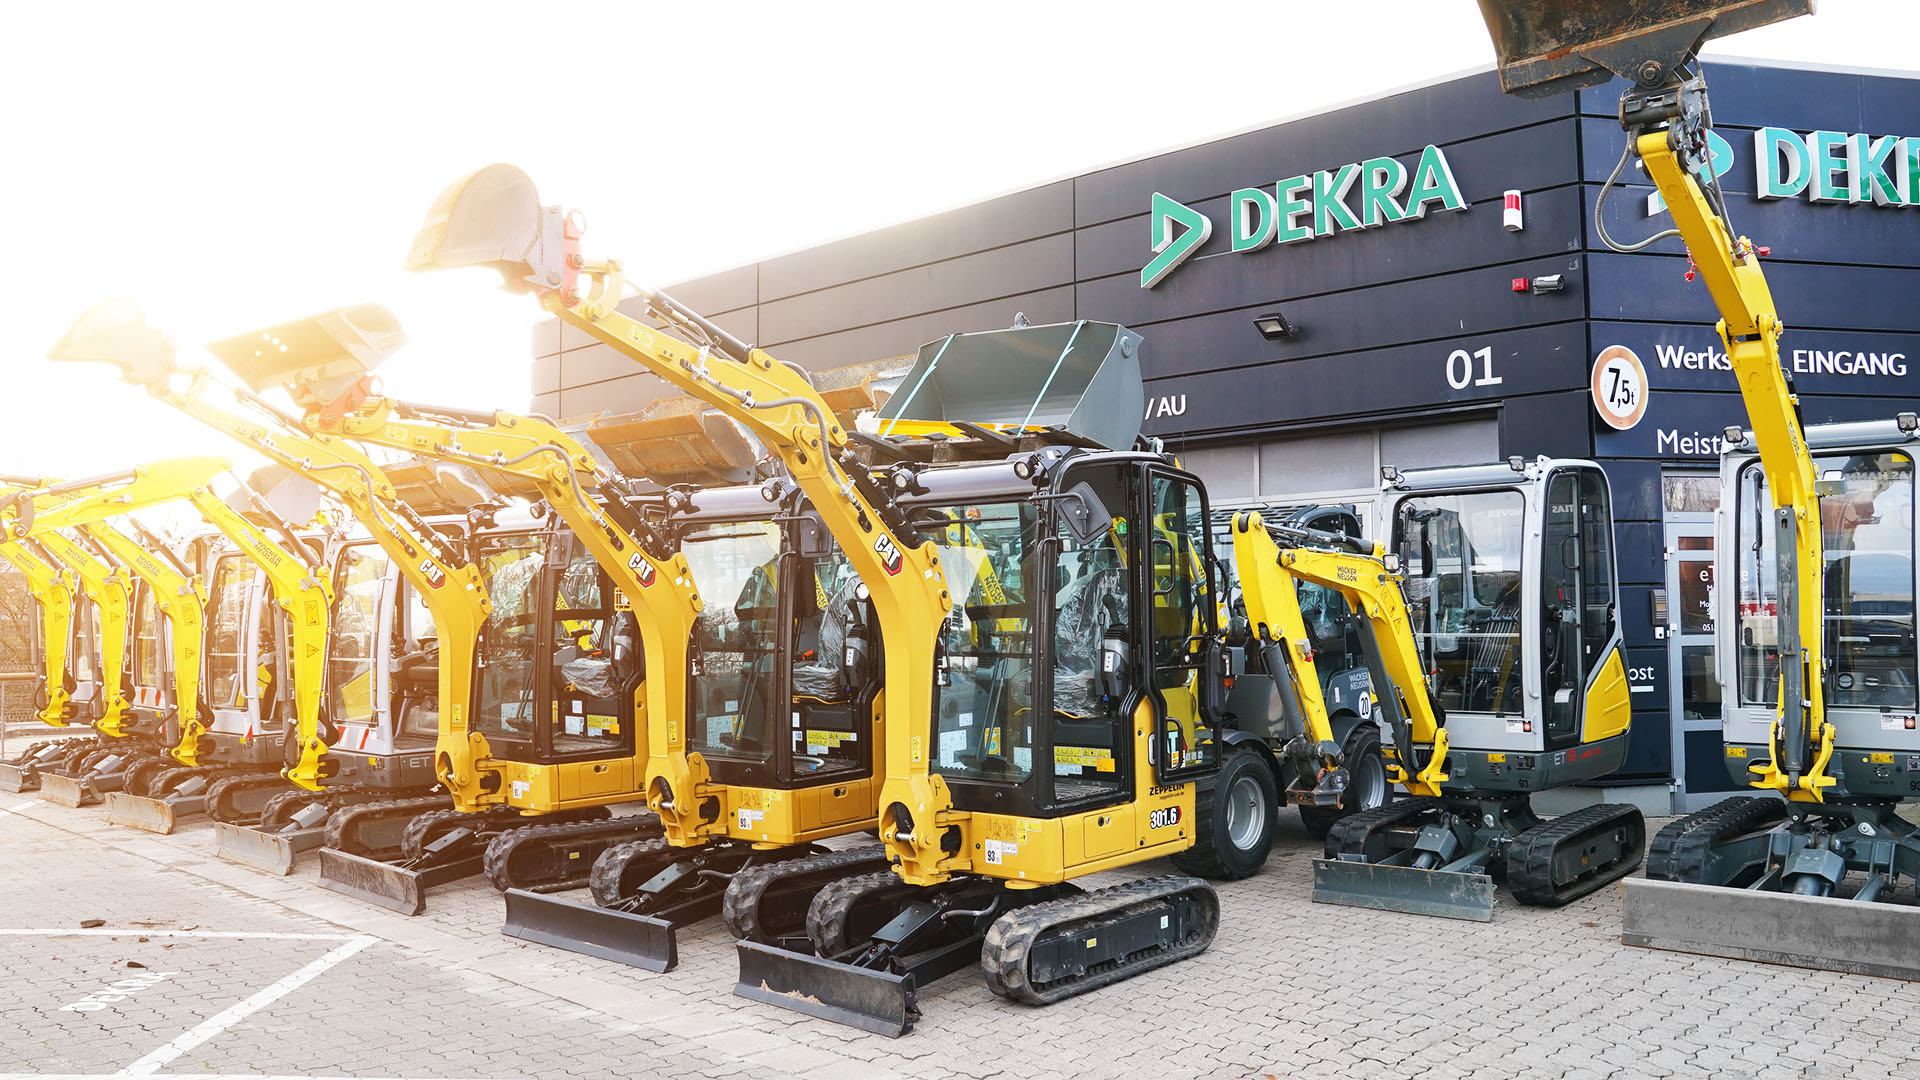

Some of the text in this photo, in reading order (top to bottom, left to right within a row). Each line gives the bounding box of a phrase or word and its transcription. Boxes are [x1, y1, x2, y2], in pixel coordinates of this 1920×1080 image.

[1231, 144, 1467, 254] DEKRA
[1446, 346, 1503, 389] 01
[1792, 349, 1907, 376] EINGANG
[255, 544, 280, 567] NEUSON
[258, 540, 281, 561] WACKER
[874, 533, 901, 568] CAT
[419, 558, 443, 583] CAT
[628, 552, 654, 581] CAT
[1337, 566, 1357, 575] WACKER
[1337, 573, 1357, 582] NEUSON
[1349, 672, 1368, 682] WACKER
[1351, 679, 1369, 690] NEUSON
[1361, 697, 1369, 715] 20
[1149, 783, 1184, 796] ZEPPELIN
[1150, 807, 1177, 829] 301.6
[987, 849, 996, 861] 93
